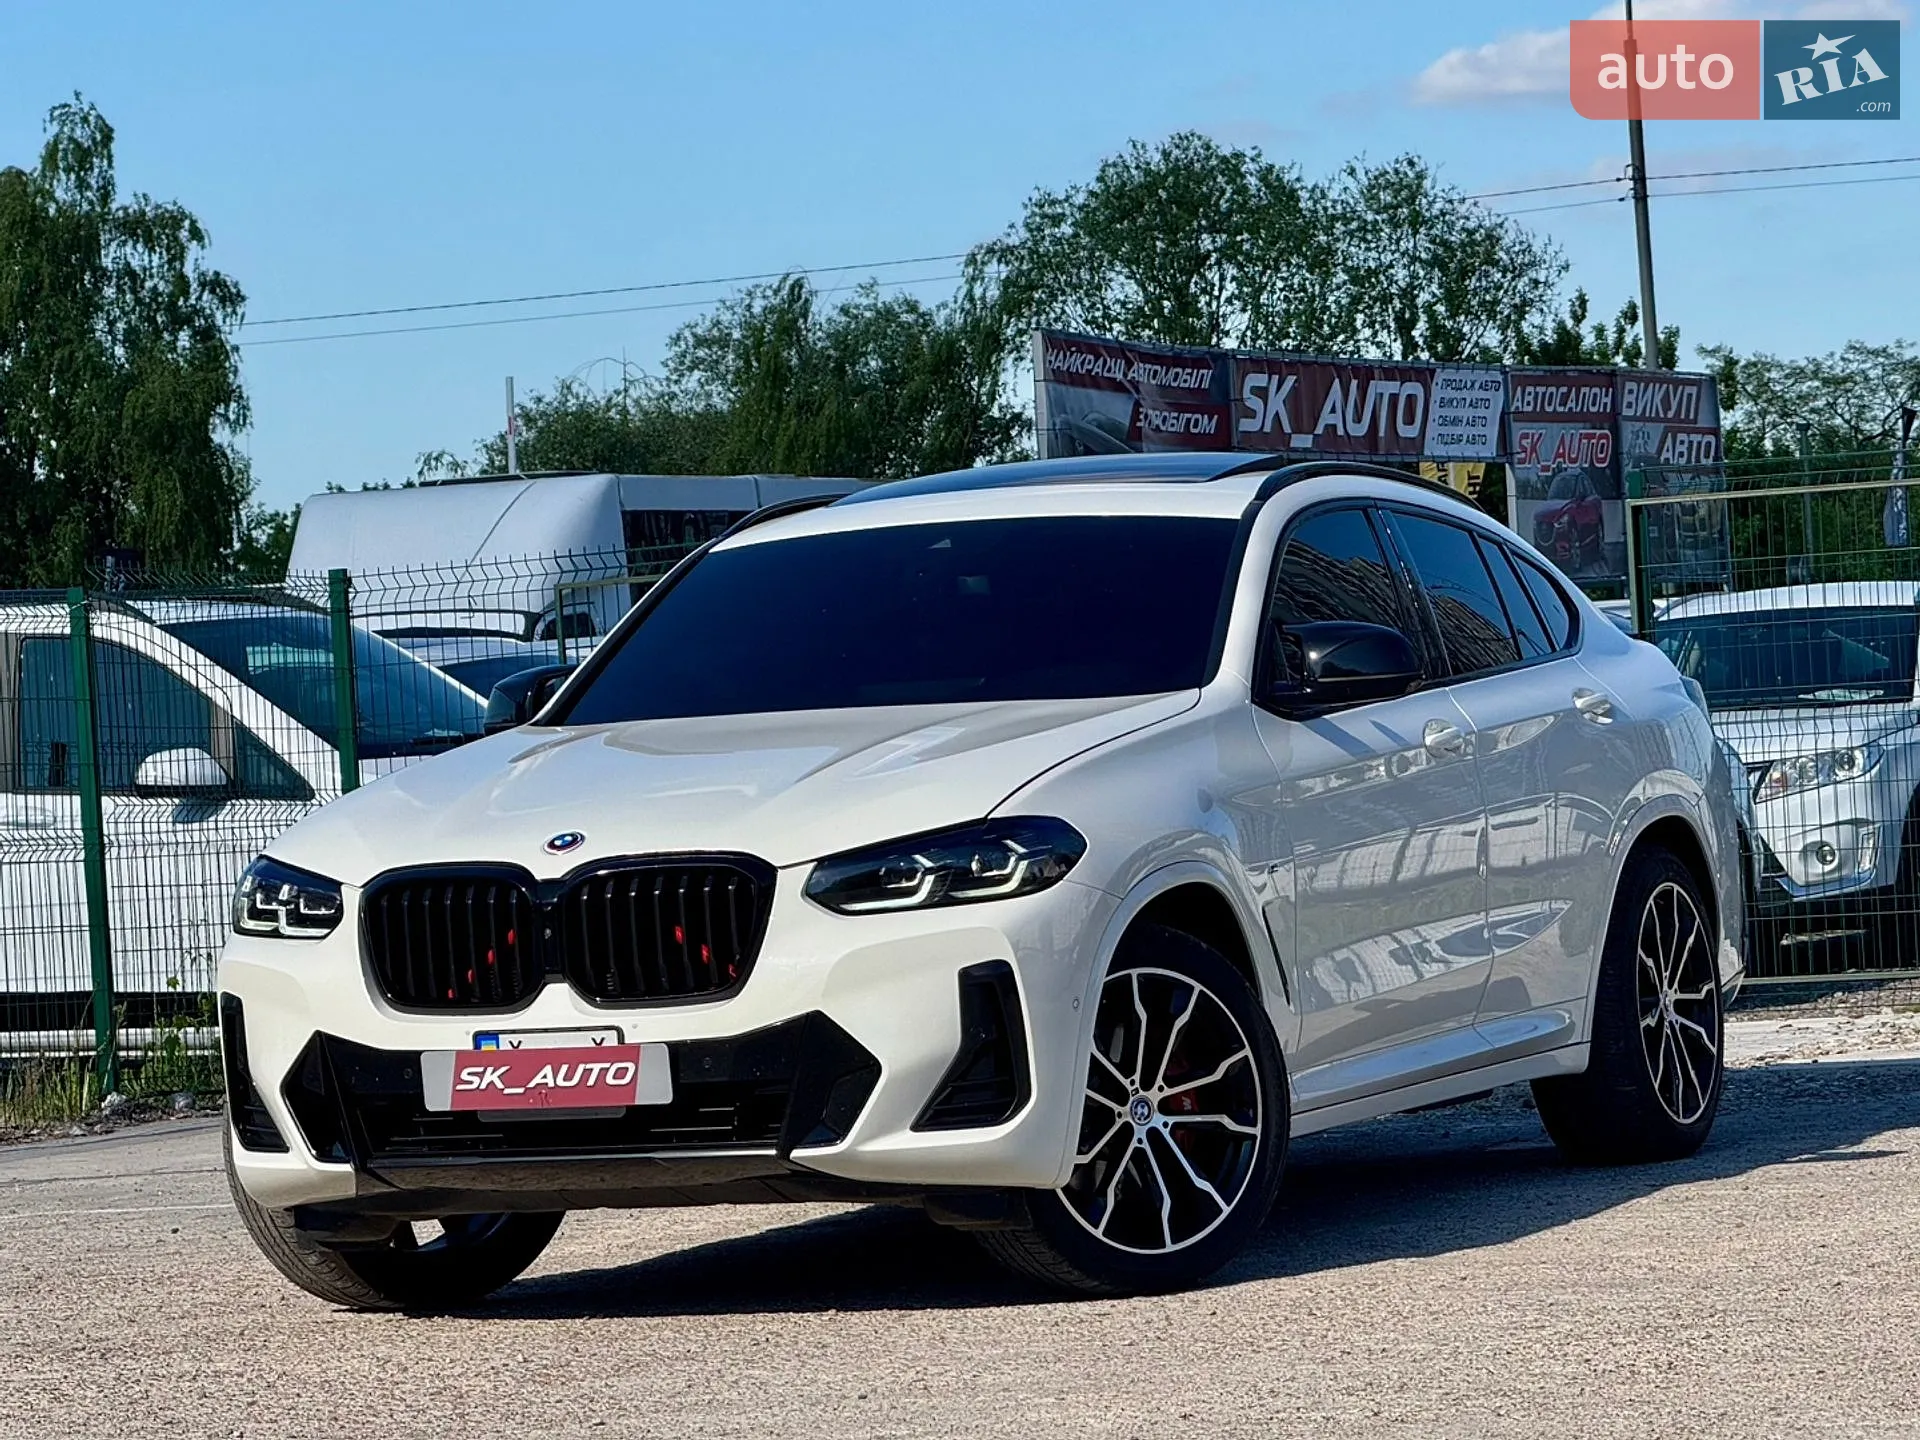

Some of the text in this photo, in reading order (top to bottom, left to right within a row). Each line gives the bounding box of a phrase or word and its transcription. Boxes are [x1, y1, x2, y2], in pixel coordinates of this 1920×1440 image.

[1046, 346, 1214, 389] НАЙКРАЩІ АВТОМОБІЛІ
[1478, 380, 1501, 392] АВТО
[1511, 385, 1613, 412] АВТОСАЛОН
[1622, 381, 1698, 420] ВИКУП
[1238, 373, 1425, 448] SK_AUTO
[1468, 397, 1491, 409] АВТО
[1465, 415, 1488, 427] АВТО
[1465, 433, 1487, 445] АВТО
[1514, 429, 1612, 475] SK_AUTO
[1660, 432, 1716, 465] АВТО
[455, 1061, 636, 1095] SK_AUTO
